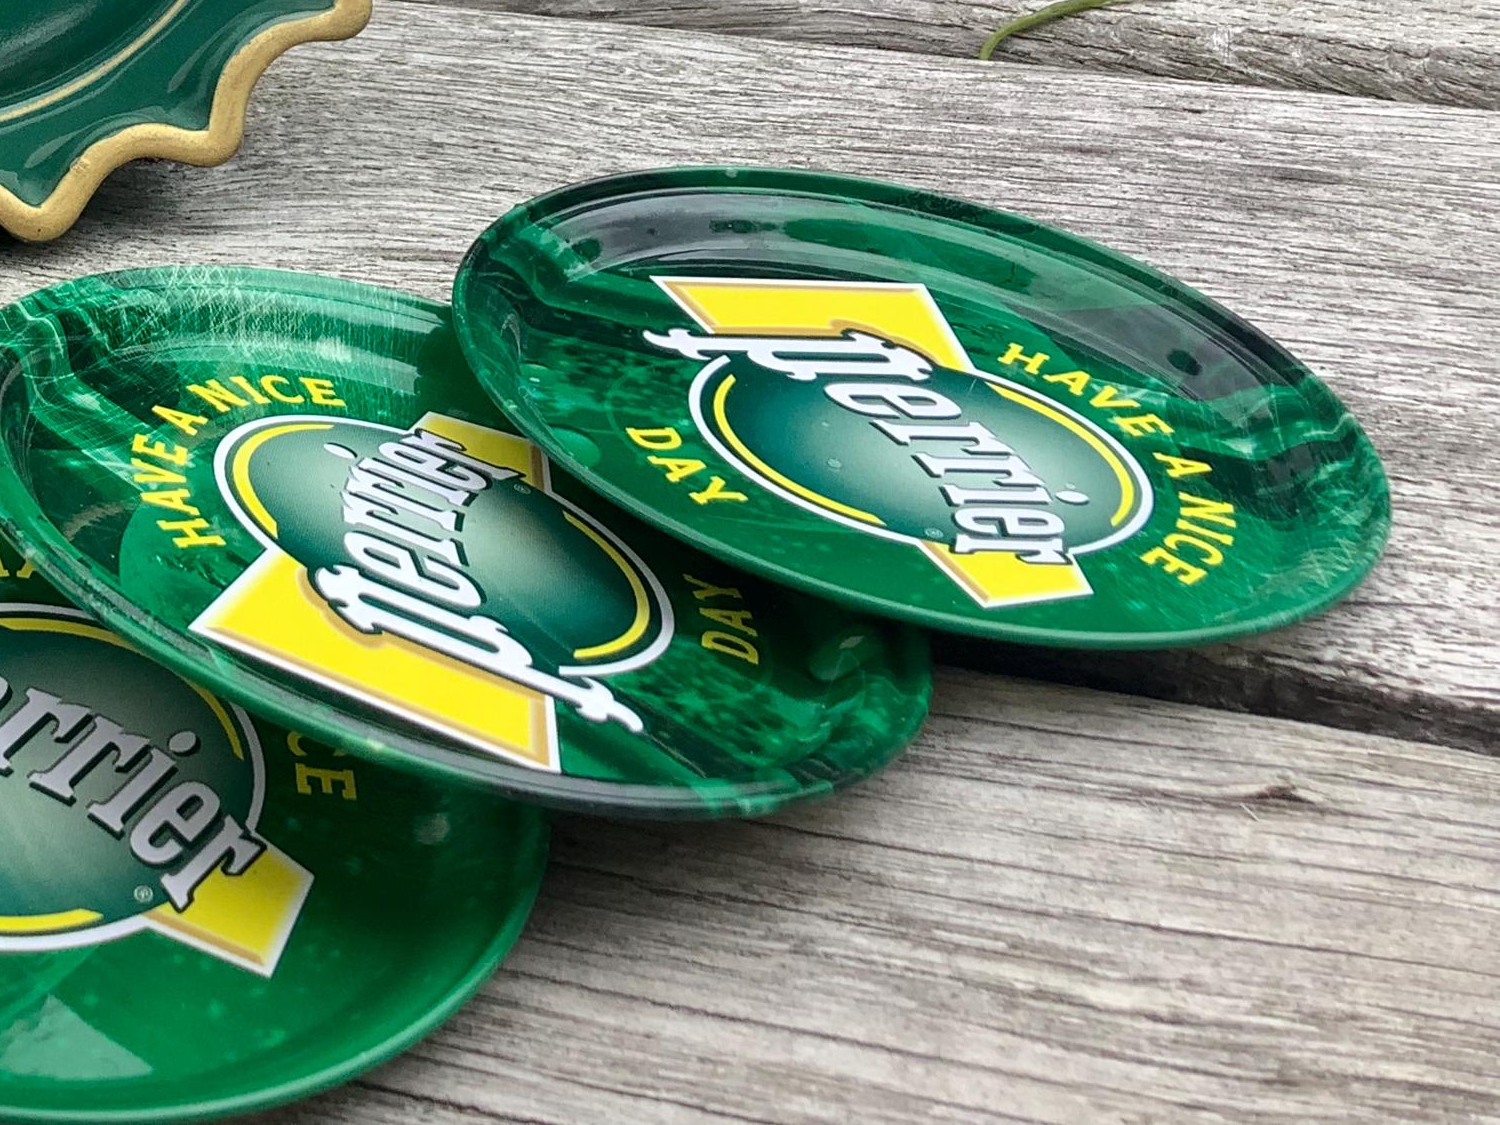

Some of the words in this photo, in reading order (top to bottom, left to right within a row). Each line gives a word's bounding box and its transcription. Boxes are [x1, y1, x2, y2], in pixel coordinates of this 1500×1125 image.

[151, 404, 209, 437] A
[185, 374, 347, 414] NICE
[997, 342, 1175, 437] HAVE
[131, 433, 227, 549] HAVE
[625, 427, 749, 505] DAY
[1152, 452, 1213, 478] A
[1139, 491, 1237, 586] NICE
[682, 574, 760, 666] DAY
